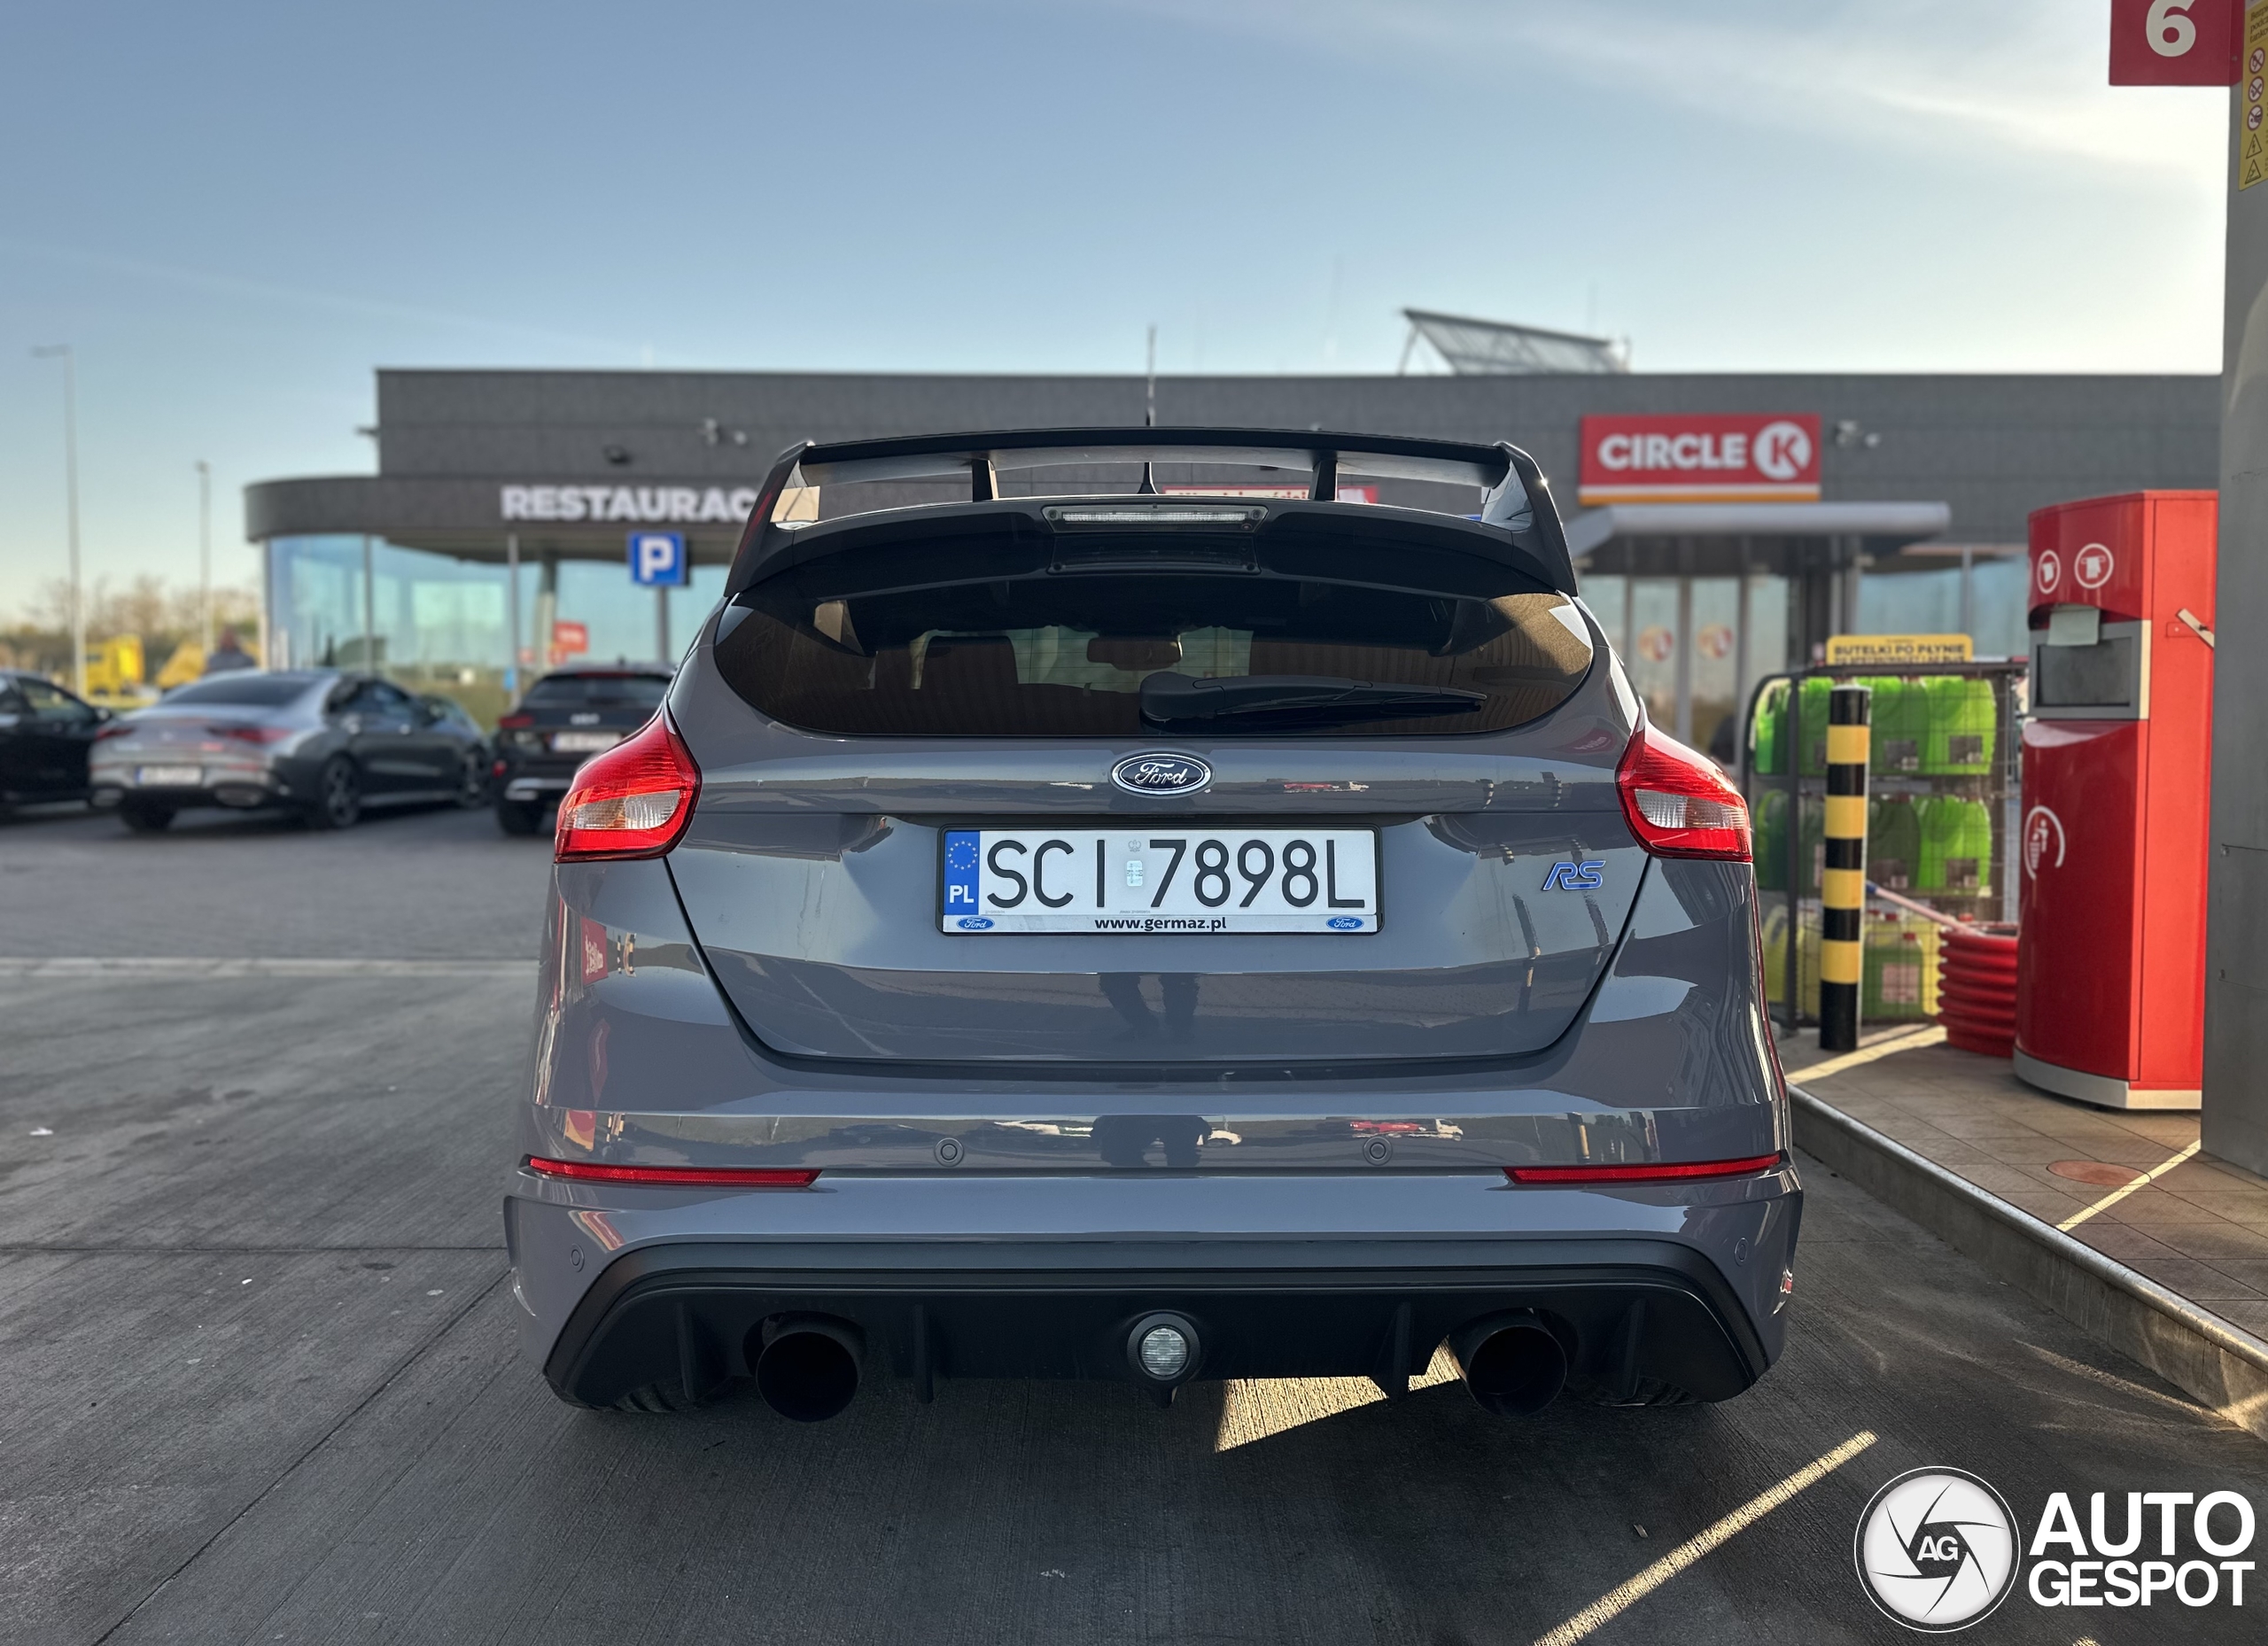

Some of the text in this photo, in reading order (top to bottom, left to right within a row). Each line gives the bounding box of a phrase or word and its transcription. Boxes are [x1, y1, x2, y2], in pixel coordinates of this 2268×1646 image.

[2146, 0, 2196, 57] 6
[1597, 429, 1808, 477] CIRCLE K
[501, 485, 757, 522] RESTAURAC
[638, 535, 674, 581] P
[1896, 645, 1915, 654] PO
[1135, 763, 1187, 785] Ford
[987, 839, 1365, 908] SCI 7898L
[1542, 860, 1606, 890] RS
[949, 885, 975, 904] PL
[964, 919, 988, 928] Ford
[1094, 917, 1227, 931] www.germaz.pl
[1333, 918, 1356, 928] Ford
